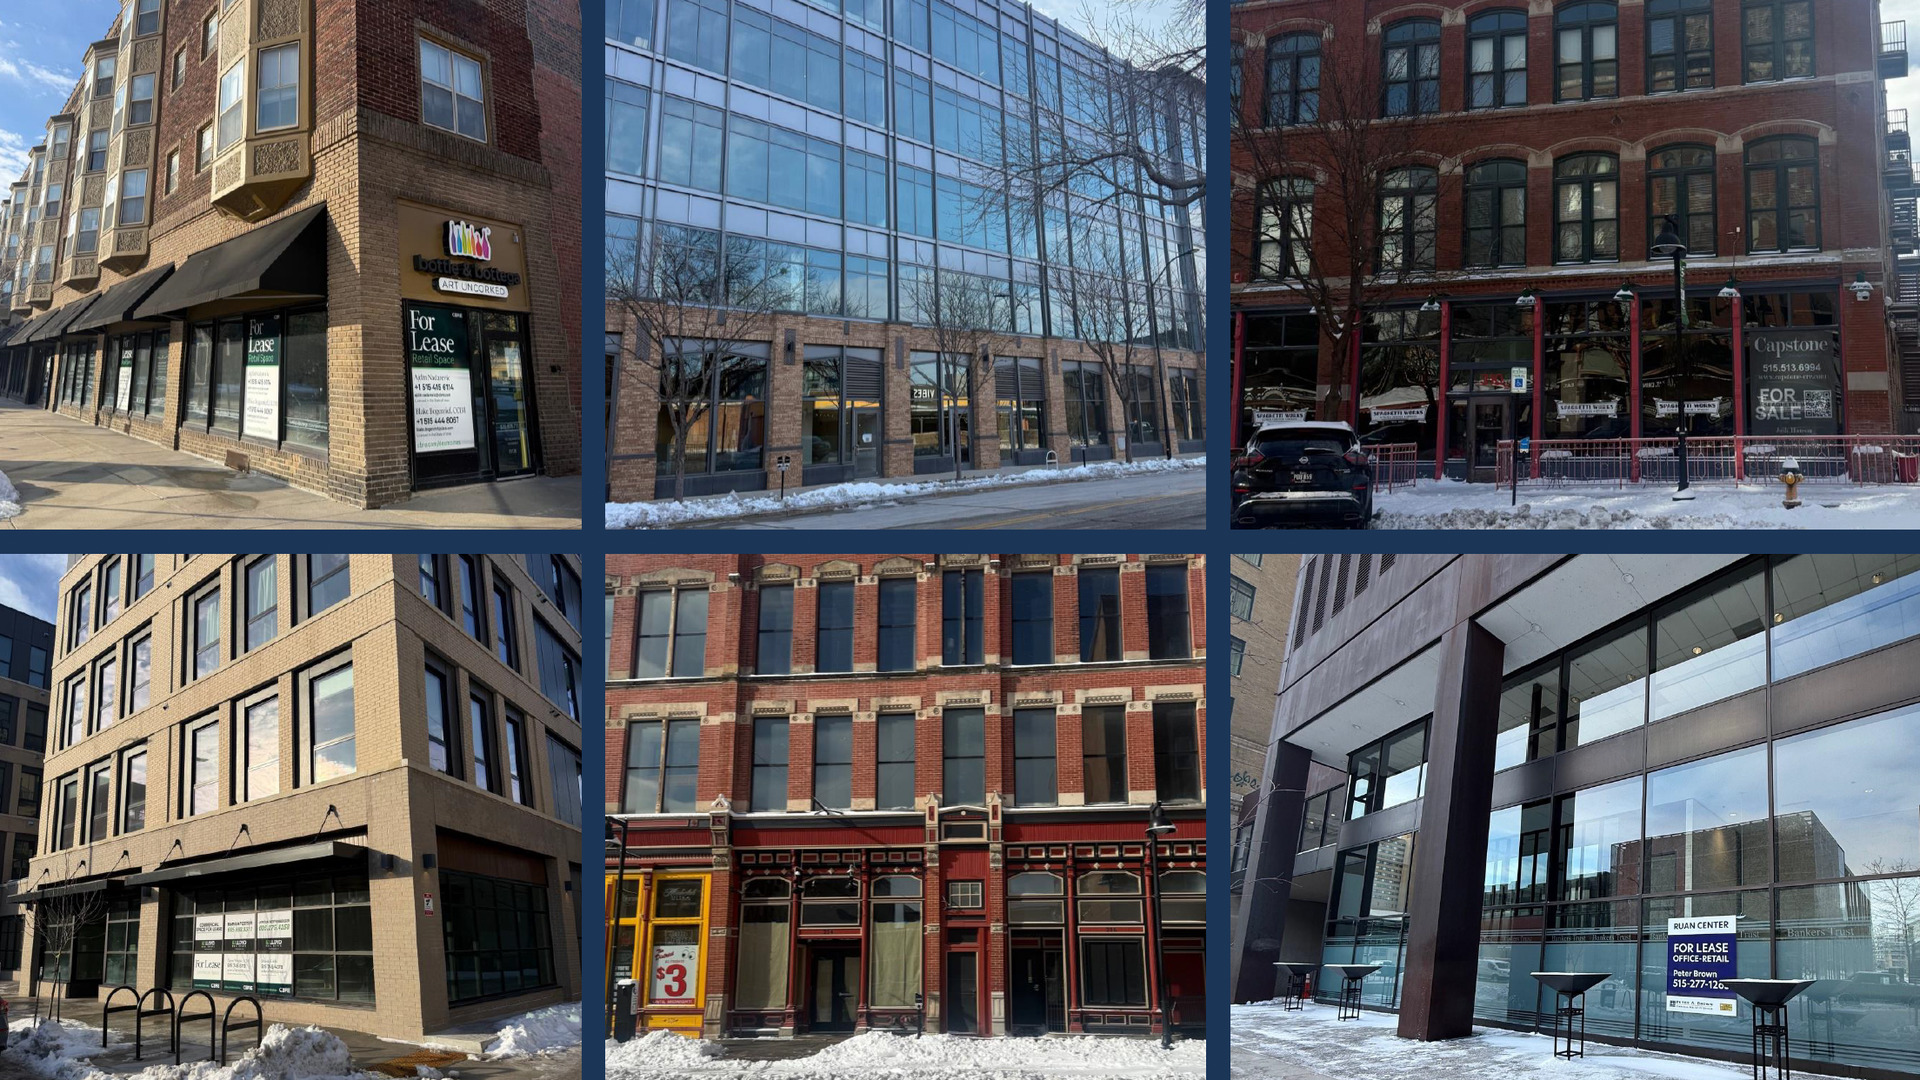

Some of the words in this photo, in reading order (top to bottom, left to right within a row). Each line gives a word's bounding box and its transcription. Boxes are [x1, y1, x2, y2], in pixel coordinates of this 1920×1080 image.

[416, 255, 459, 276] bottle
[463, 264, 472, 278] &
[475, 265, 520, 286] bottega
[442, 280, 458, 290] ART
[461, 283, 506, 296] UNCORKED
[250, 319, 264, 336] For
[410, 309, 435, 331] For
[249, 336, 274, 353] Lease
[410, 330, 455, 353] Lease
[1754, 337, 1829, 358] Capstone
[413, 353, 433, 364] Retail
[433, 353, 455, 366] Space
[1762, 363, 1822, 373] 515.513.6994
[1759, 388, 1797, 403] FOR
[1755, 405, 1802, 420] SALE
[1673, 922, 1696, 930] RUAN
[1697, 920, 1729, 929] CENTER
[1787, 928, 1825, 937] Bankers
[1829, 927, 1855, 936] Trust
[1673, 943, 1694, 953] FOR
[1696, 942, 1729, 953] LEASE
[195, 960, 204, 969] For
[204, 960, 221, 969] Lease
[1672, 954, 1730, 963] OFFICE-RETAIL
[656, 964, 687, 997] $3
[1673, 969, 1692, 977] Peter
[1693, 970, 1718, 978] Brown
